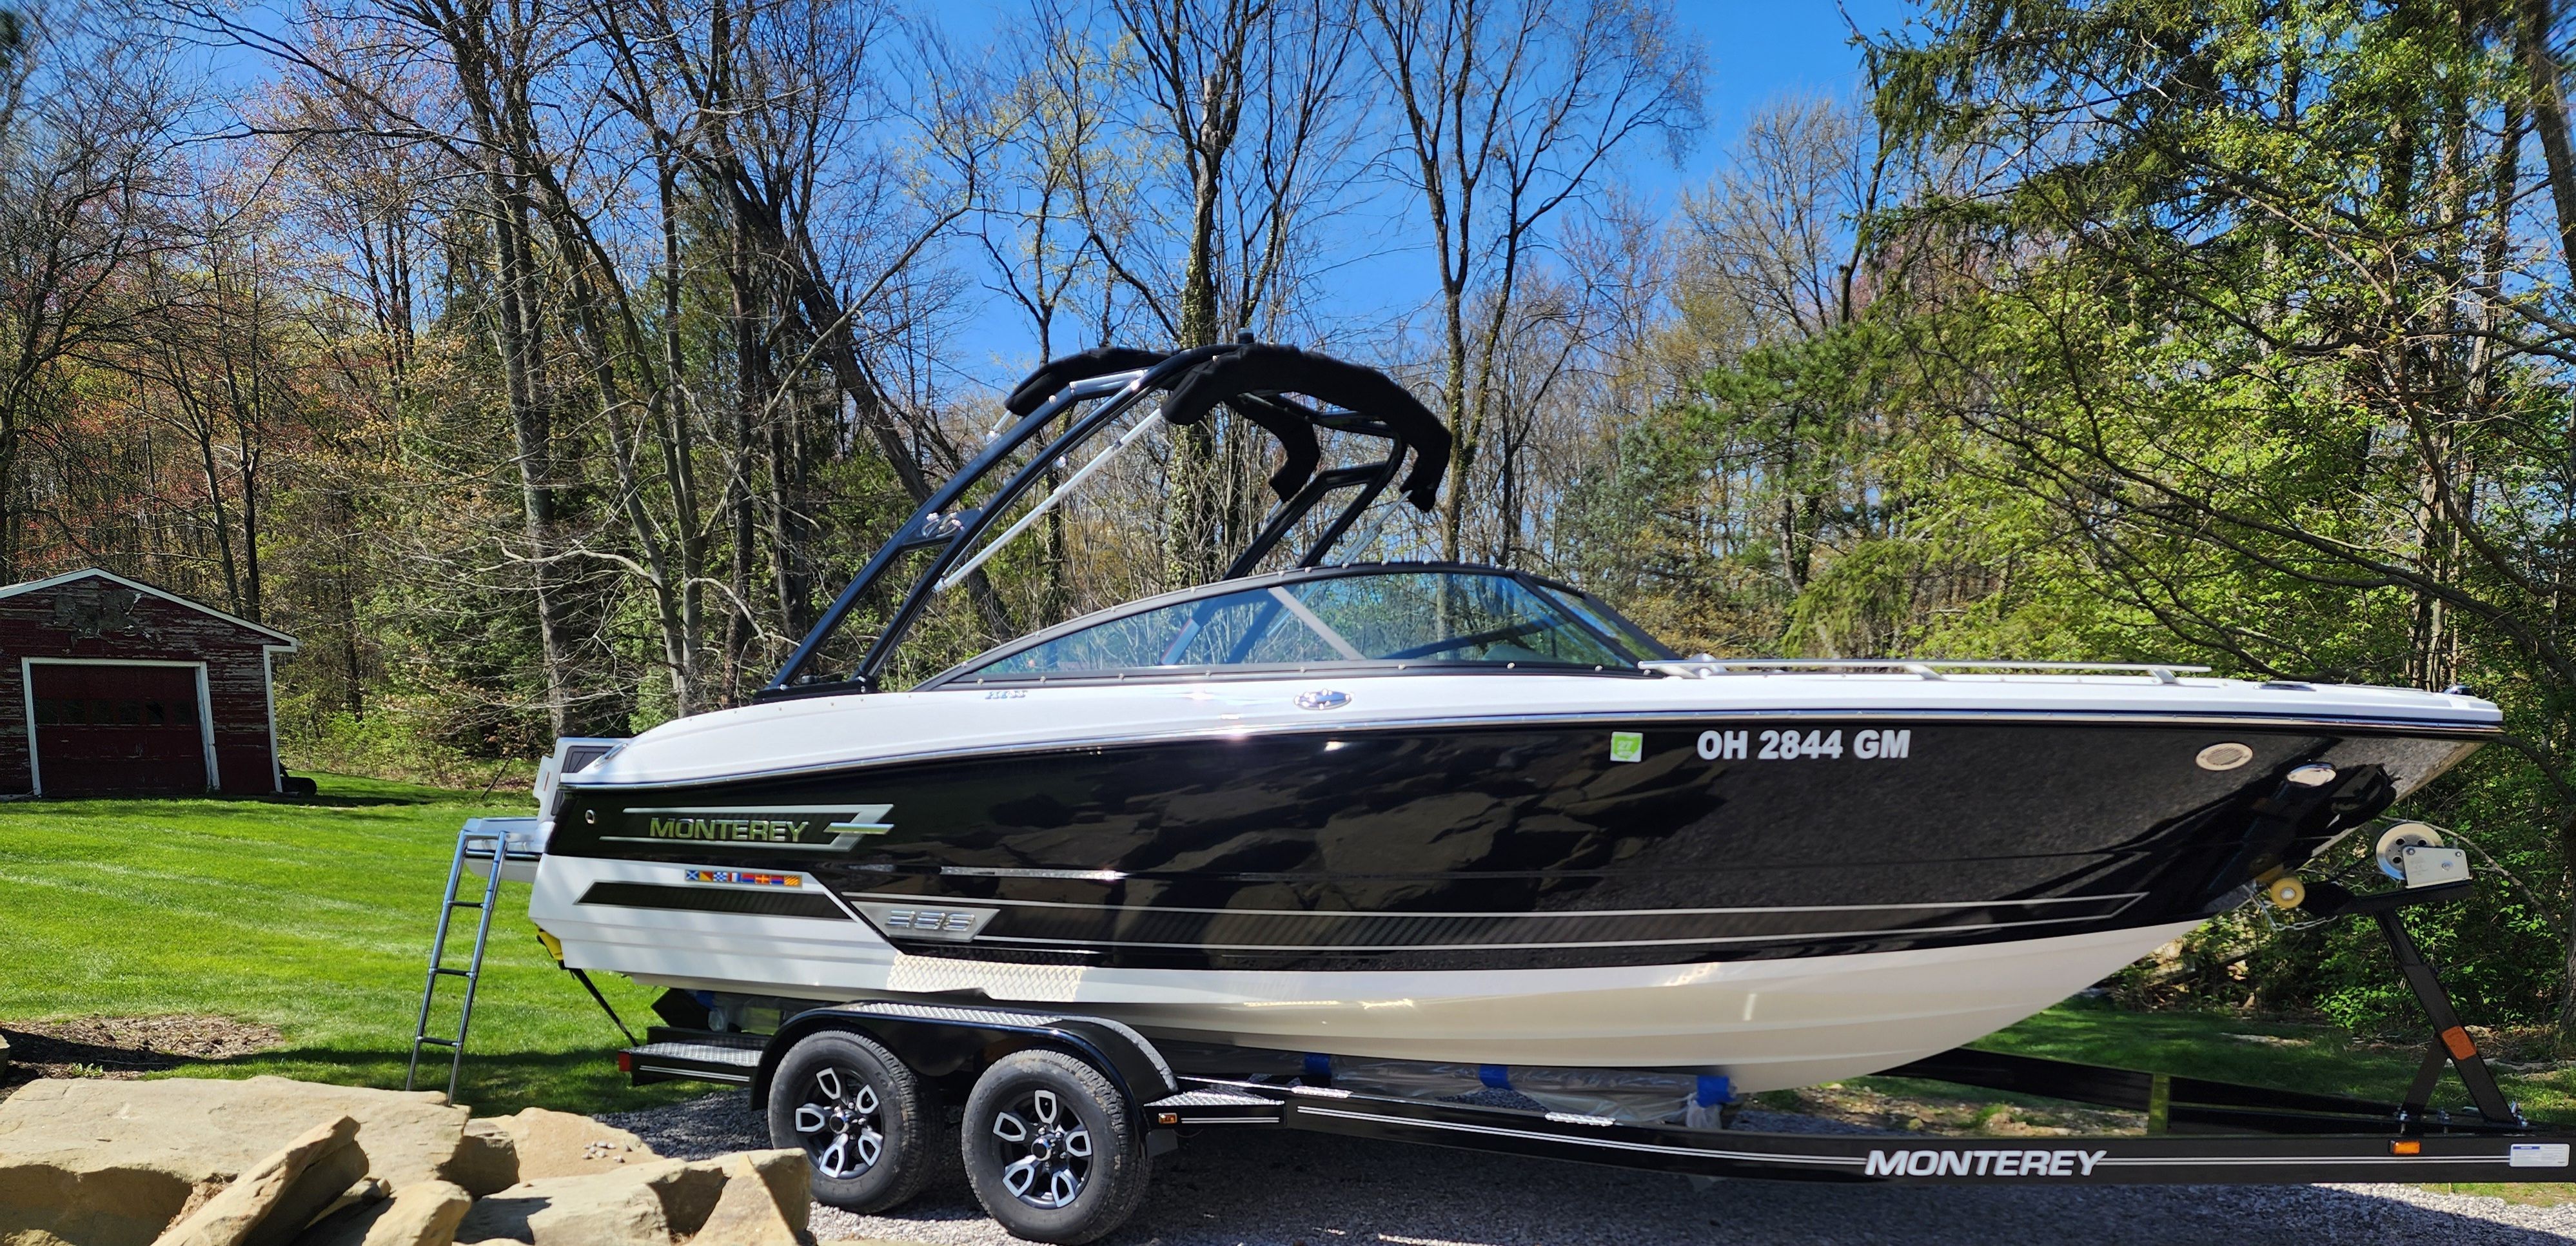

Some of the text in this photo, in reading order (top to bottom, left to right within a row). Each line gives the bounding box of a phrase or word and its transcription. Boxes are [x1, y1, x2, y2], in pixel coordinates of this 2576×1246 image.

[1697, 729, 1911, 760] OH 2844 GM
[650, 817, 809, 842] MONTEREY
[1864, 1150, 2107, 1176] MONTEREY
